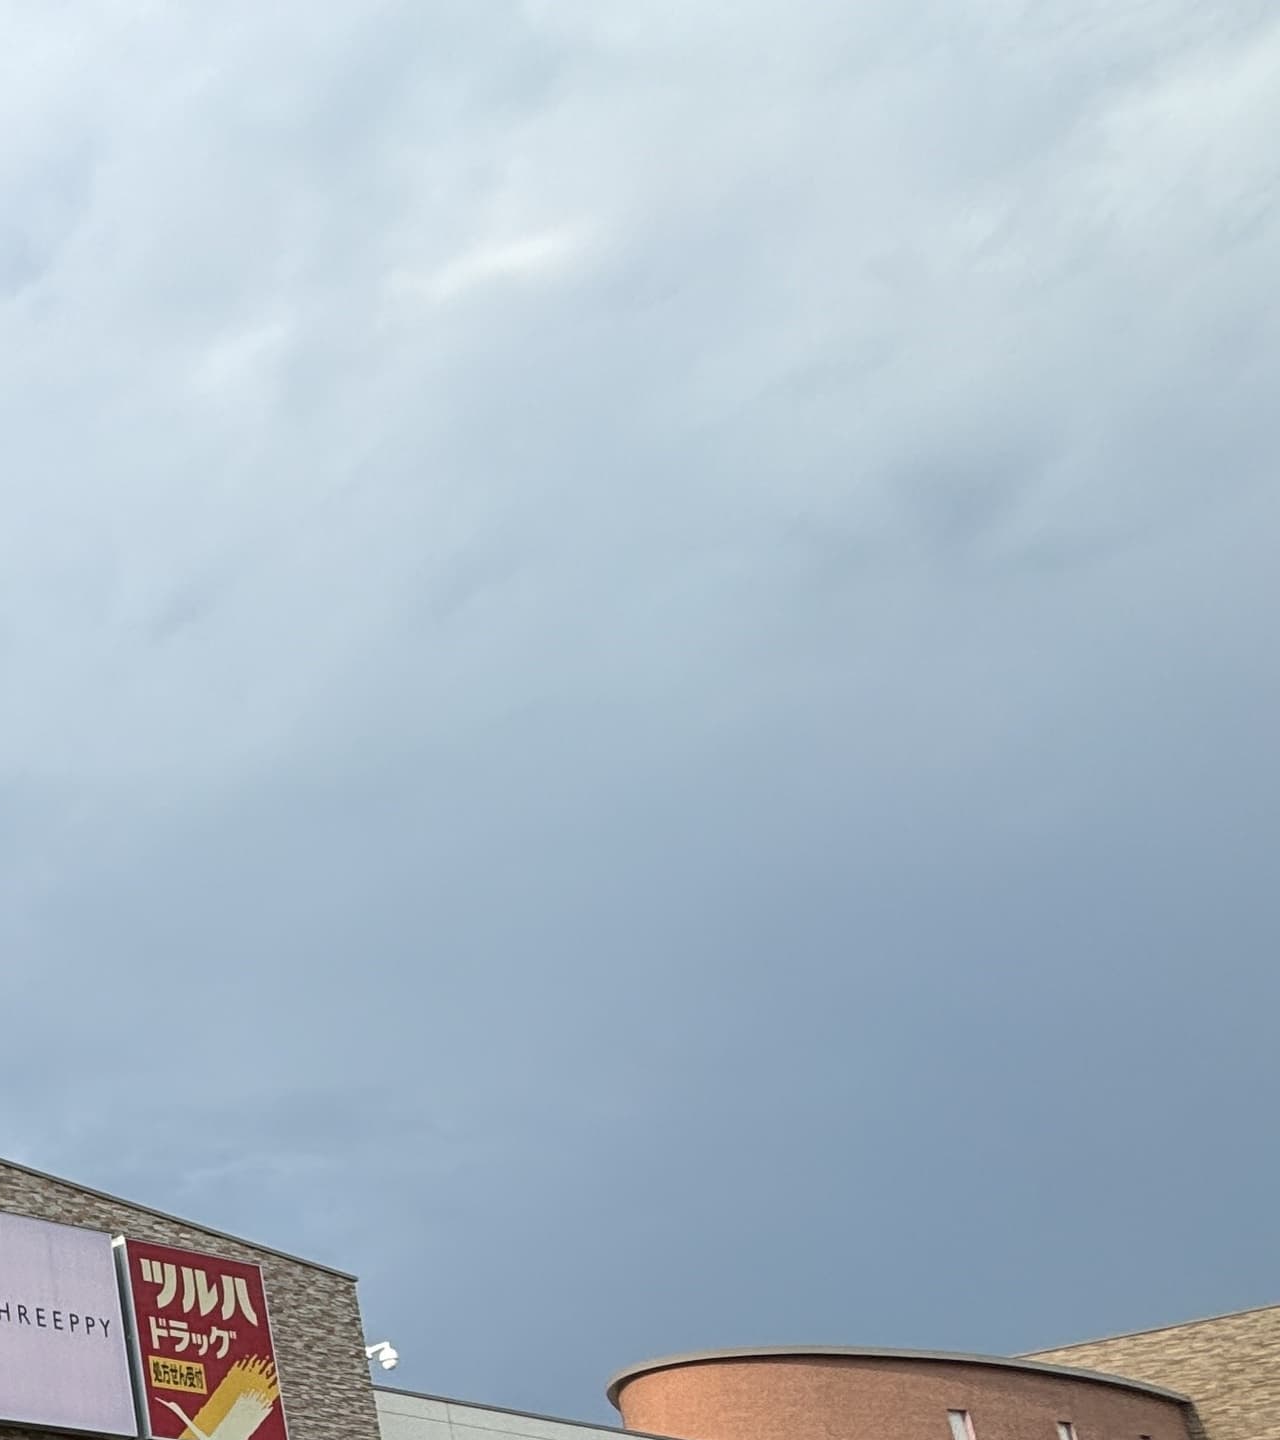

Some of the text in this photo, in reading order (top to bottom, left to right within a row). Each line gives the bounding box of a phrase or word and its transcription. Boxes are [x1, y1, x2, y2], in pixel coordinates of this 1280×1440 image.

[139, 1257, 259, 1328] ツルハ
[148, 1316, 238, 1360] ドラッグ
[151, 1359, 205, 1390] 処方せん受付
